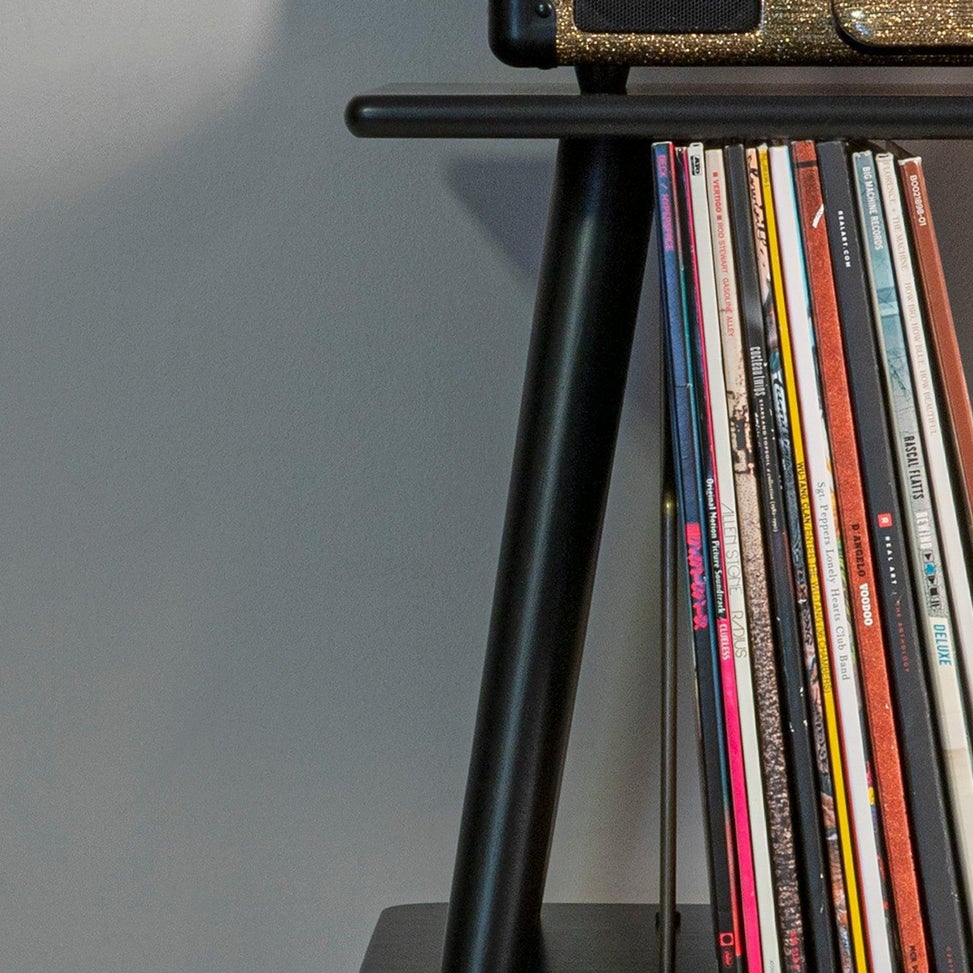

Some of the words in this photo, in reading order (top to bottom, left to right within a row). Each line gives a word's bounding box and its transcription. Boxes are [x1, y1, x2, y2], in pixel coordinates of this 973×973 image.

[862, 166, 872, 180] BIG
[883, 161, 895, 202] FLORENCE
[713, 179, 722, 213] VERTIGO
[865, 182, 877, 214] MACHINE
[838, 211, 851, 268] REALART.COM
[871, 216, 883, 250] RECORDS
[892, 216, 901, 231] THE
[718, 240, 728, 273] STEWART
[896, 234, 908, 271] MACHINE
[723, 277, 732, 314] GASOLINE
[904, 282, 914, 302] HOW
[912, 322, 921, 342] HOW
[726, 316, 735, 337] ALLEY
[903, 435, 919, 468] RASCAL
[706, 479, 715, 510] Original
[796, 461, 808, 500] WU-TANG
[816, 481, 826, 501] Sgt.
[909, 470, 924, 500] FLATTS
[709, 511, 718, 539] Motion
[722, 503, 737, 544] ALLEN
[818, 505, 832, 545] Peppers
[712, 540, 721, 568] Picture
[885, 536, 894, 562] REAL
[824, 549, 837, 584] Lonely
[851, 524, 866, 577] D'ANGELO
[859, 583, 874, 626] VOODOO
[889, 566, 898, 586] ART
[715, 570, 725, 614] Soundtrack
[831, 588, 842, 621] Hearts
[720, 623, 730, 660] CLUELESS
[732, 610, 747, 658] RADIUS
[836, 626, 846, 651] Club
[897, 622, 910, 673] ANTHOLOGY
[933, 624, 951, 666] DELUXE
[840, 655, 850, 681] Band
